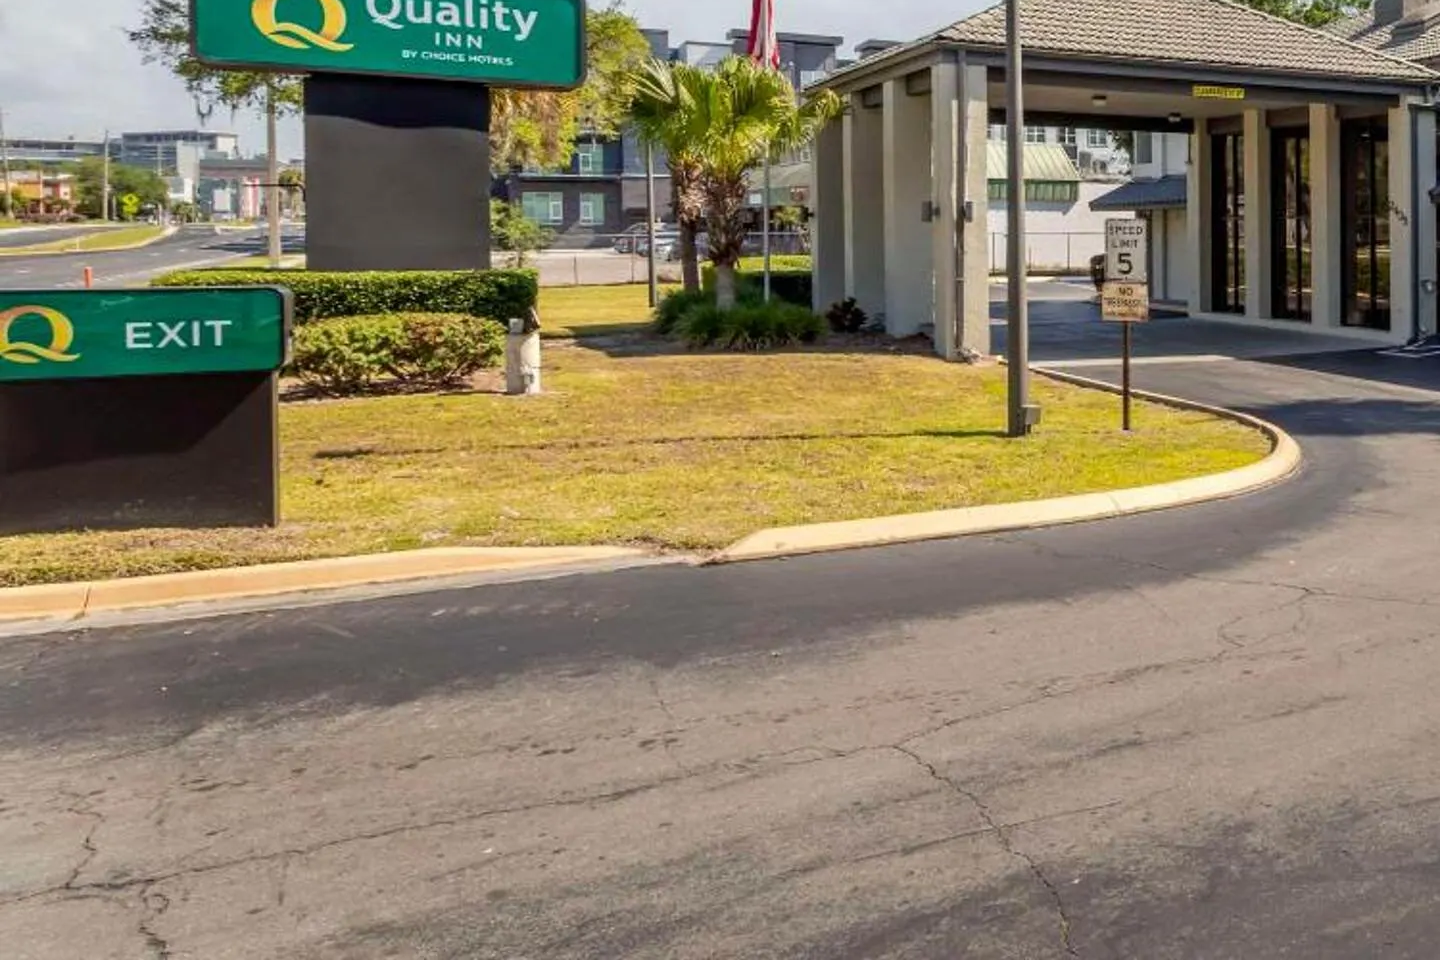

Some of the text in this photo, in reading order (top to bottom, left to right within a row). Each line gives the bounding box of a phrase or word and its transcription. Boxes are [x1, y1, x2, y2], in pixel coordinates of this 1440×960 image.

[434, 32, 483, 49] INN
[402, 49, 418, 58] BY
[421, 51, 466, 62] CHOICE
[1109, 226, 1143, 235] SPEED
[1111, 240, 1138, 248] LIMIT
[1117, 253, 1133, 275] 5
[124, 319, 232, 350] EXIT
